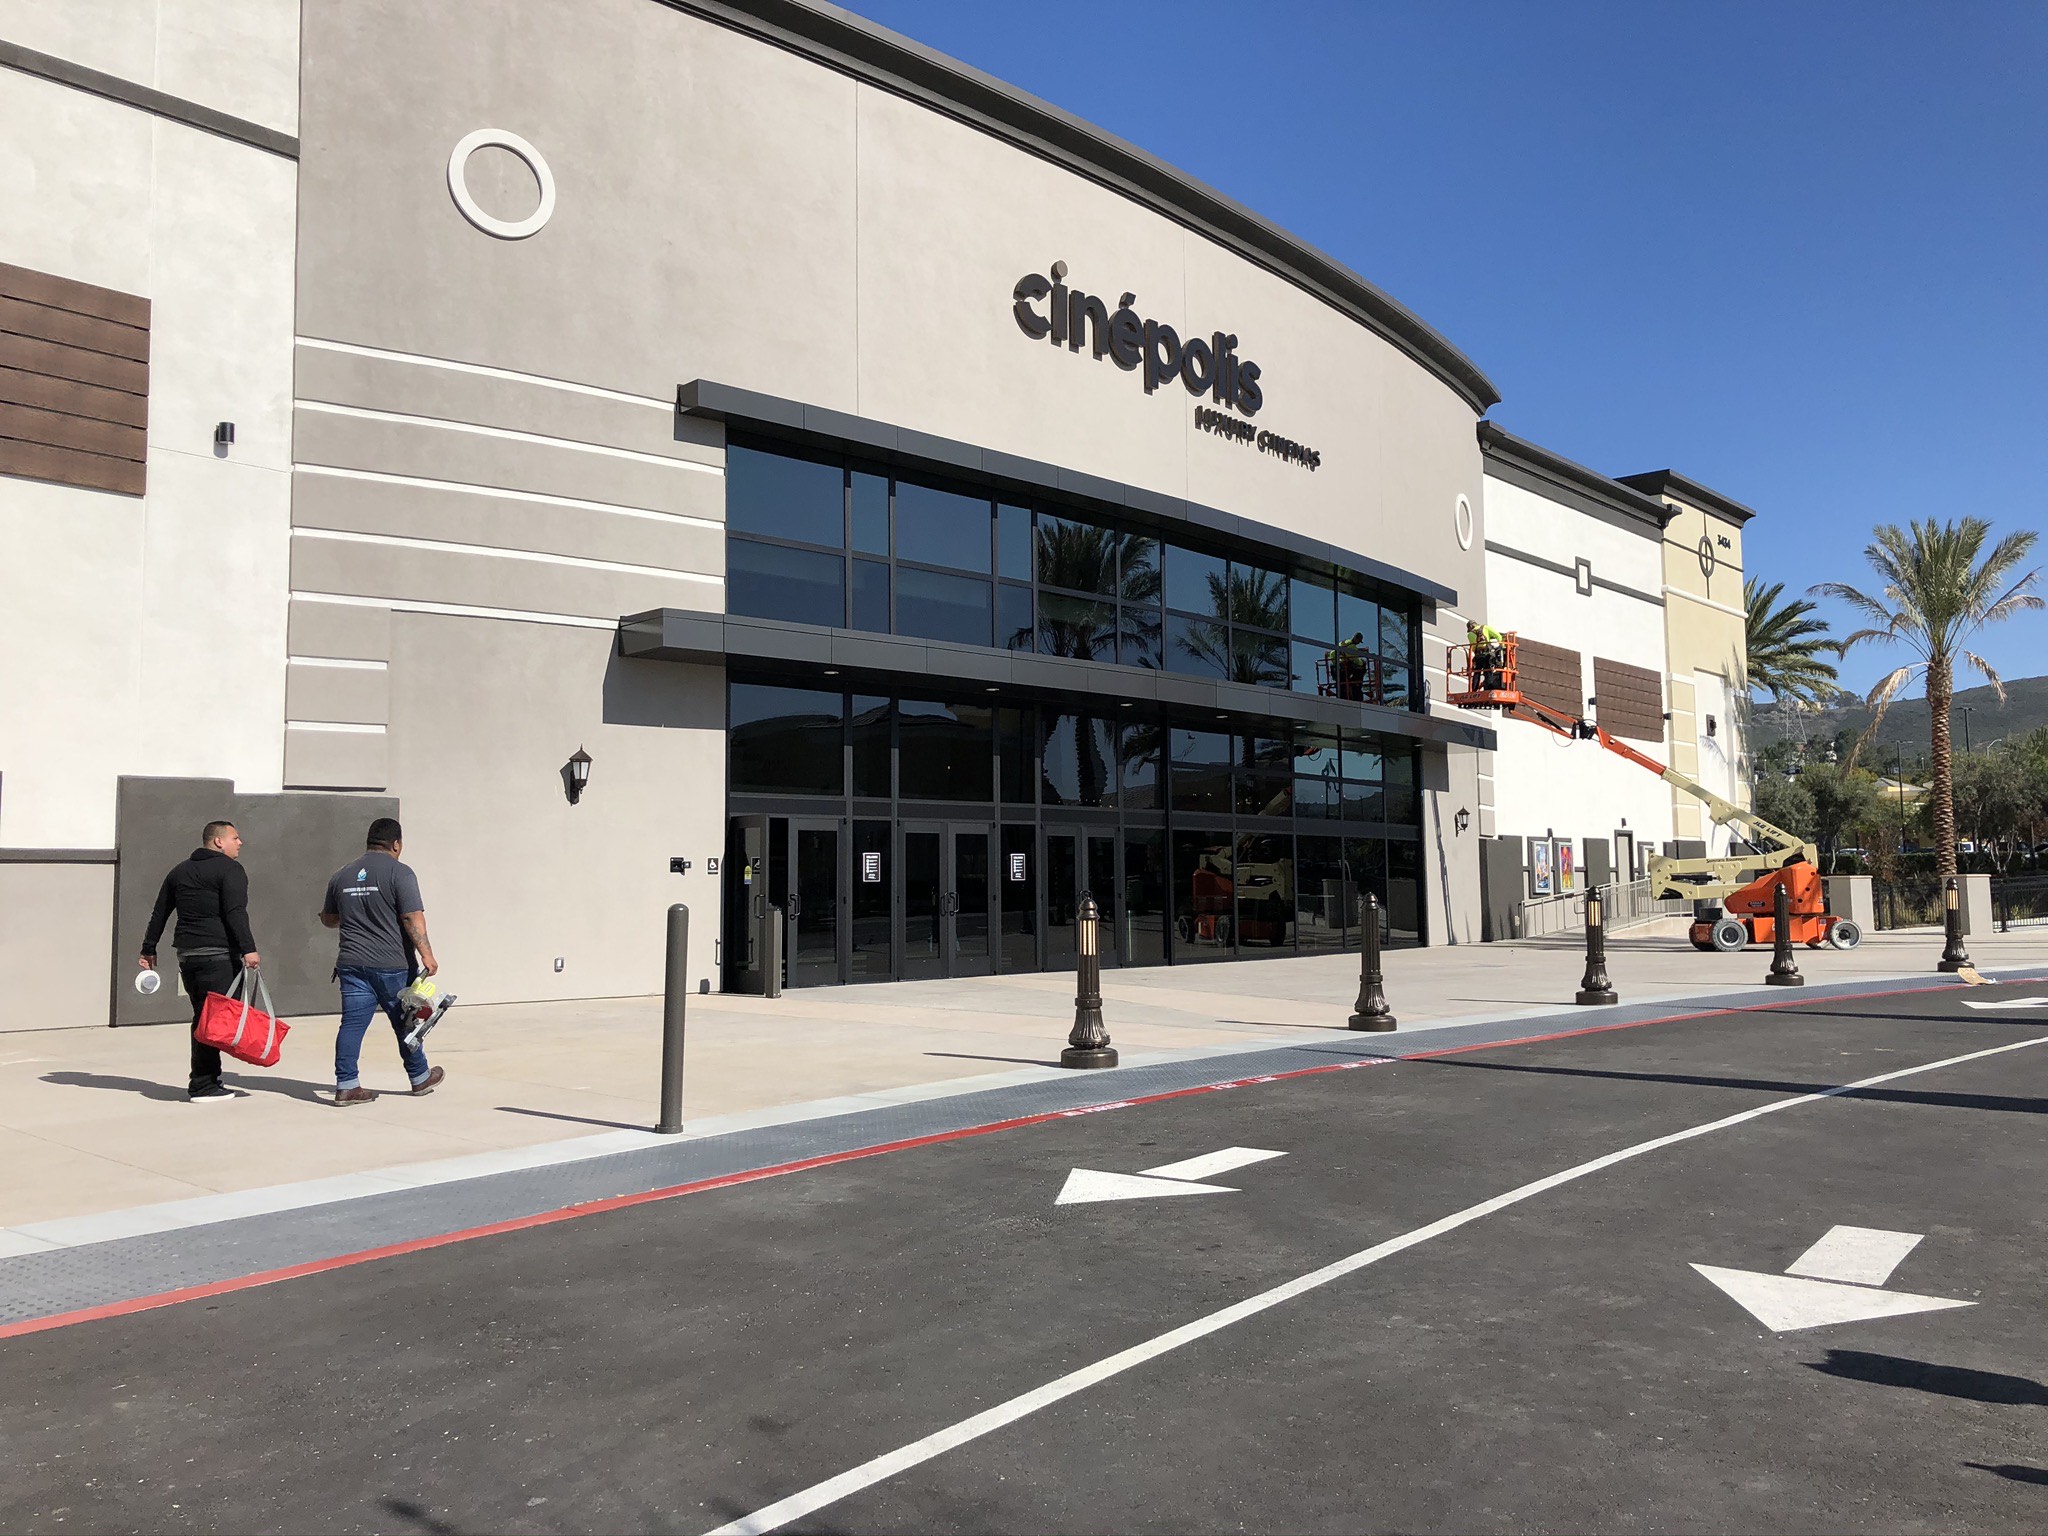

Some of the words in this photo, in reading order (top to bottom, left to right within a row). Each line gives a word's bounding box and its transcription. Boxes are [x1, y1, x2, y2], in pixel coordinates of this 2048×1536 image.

[1013, 259, 1263, 417] cinépolis
[1194, 405, 1257, 447] LUXURY
[1257, 429, 1321, 472] CINEMAS
[1753, 821, 1766, 829] JLG
[1766, 827, 1782, 837] LIFT
